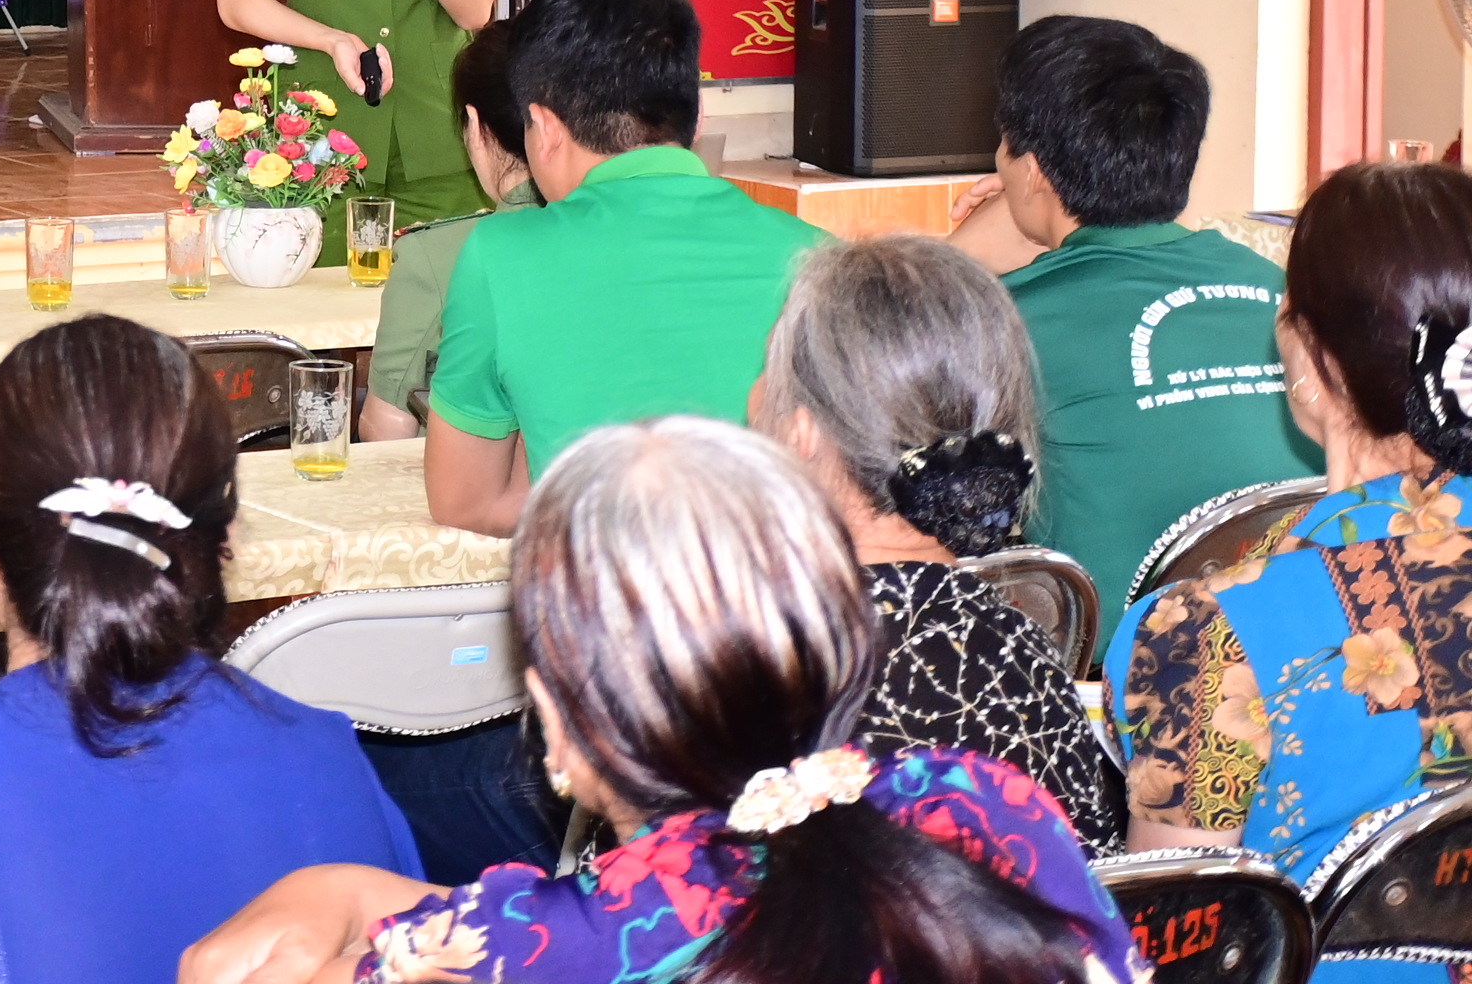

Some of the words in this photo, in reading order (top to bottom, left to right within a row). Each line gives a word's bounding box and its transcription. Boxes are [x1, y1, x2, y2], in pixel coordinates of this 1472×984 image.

[1129, 324, 1153, 387] NGƯỜI
[1141, 300, 1171, 327] GÌN
[1164, 286, 1197, 308] GIỮ
[1197, 285, 1270, 303] TƯƠNG
